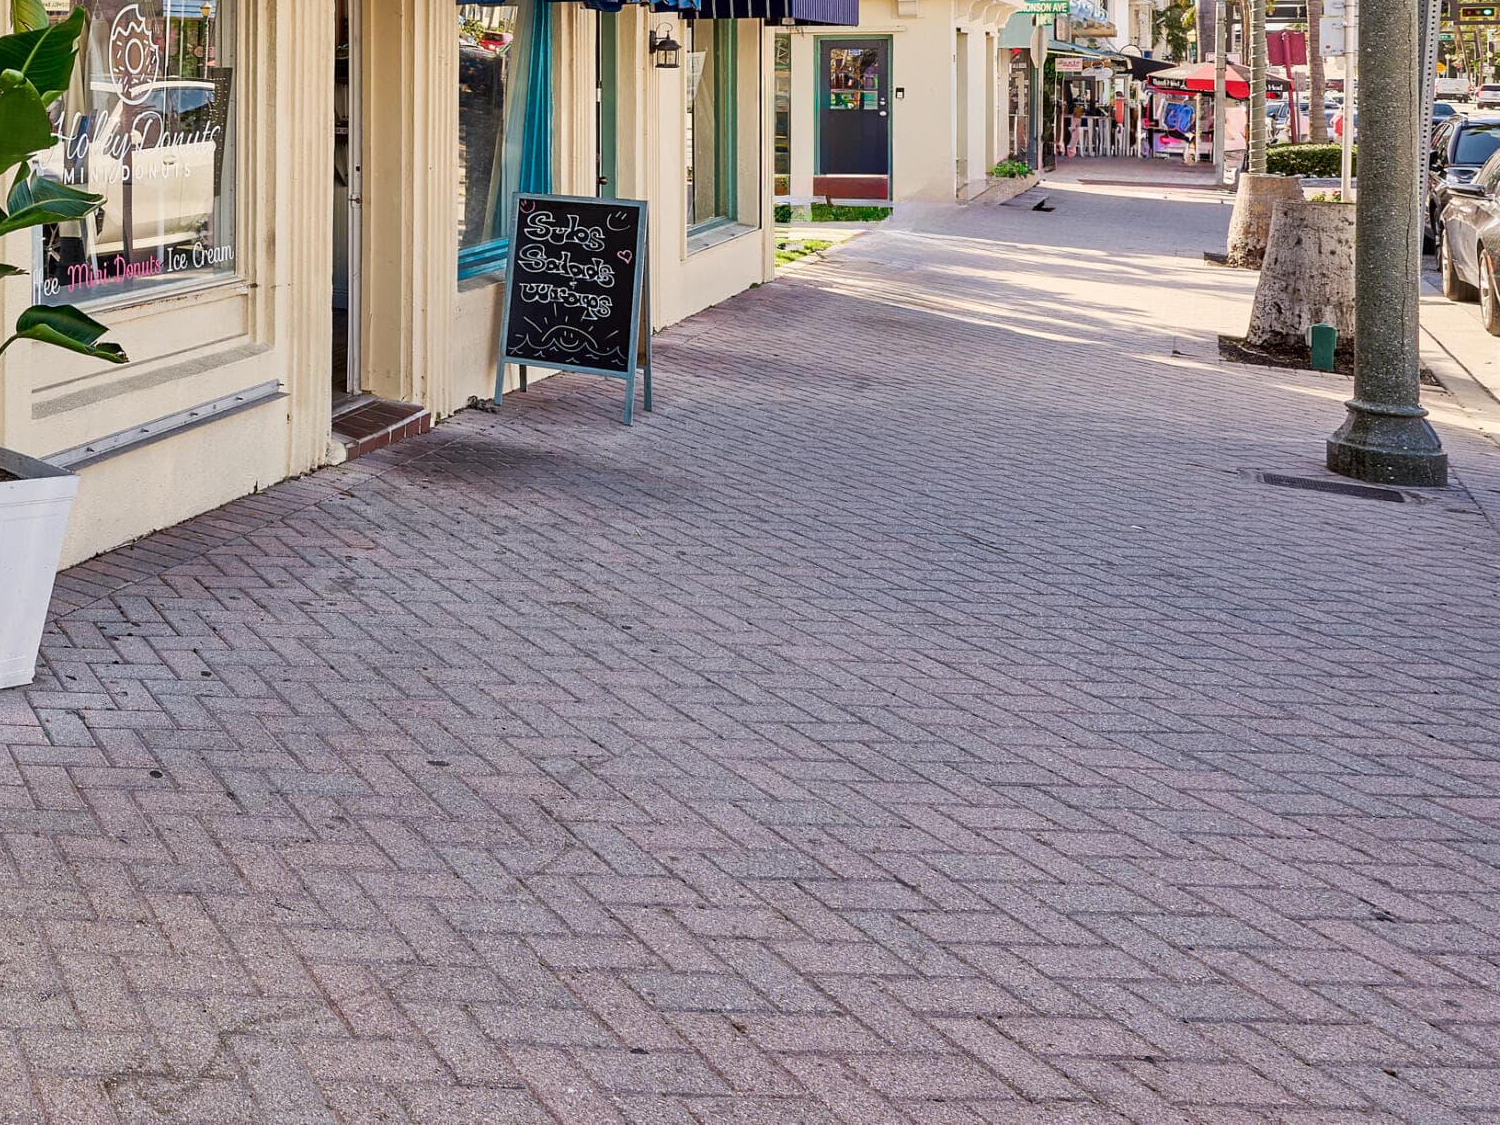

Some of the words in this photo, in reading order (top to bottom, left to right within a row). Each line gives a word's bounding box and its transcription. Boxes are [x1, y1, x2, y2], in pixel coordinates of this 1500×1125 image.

[1053, 2, 1067, 12] AVE
[46, 110, 132, 184] Holey
[132, 111, 220, 156] Donuts
[121, 163, 191, 182] DONUTS
[524, 210, 606, 252] Subs
[33, 268, 61, 305] ffee
[67, 261, 110, 293] Mini
[114, 254, 162, 283] Donuts
[166, 247, 188, 273] Ice
[192, 241, 235, 268] Cream
[517, 243, 615, 288] Salads
